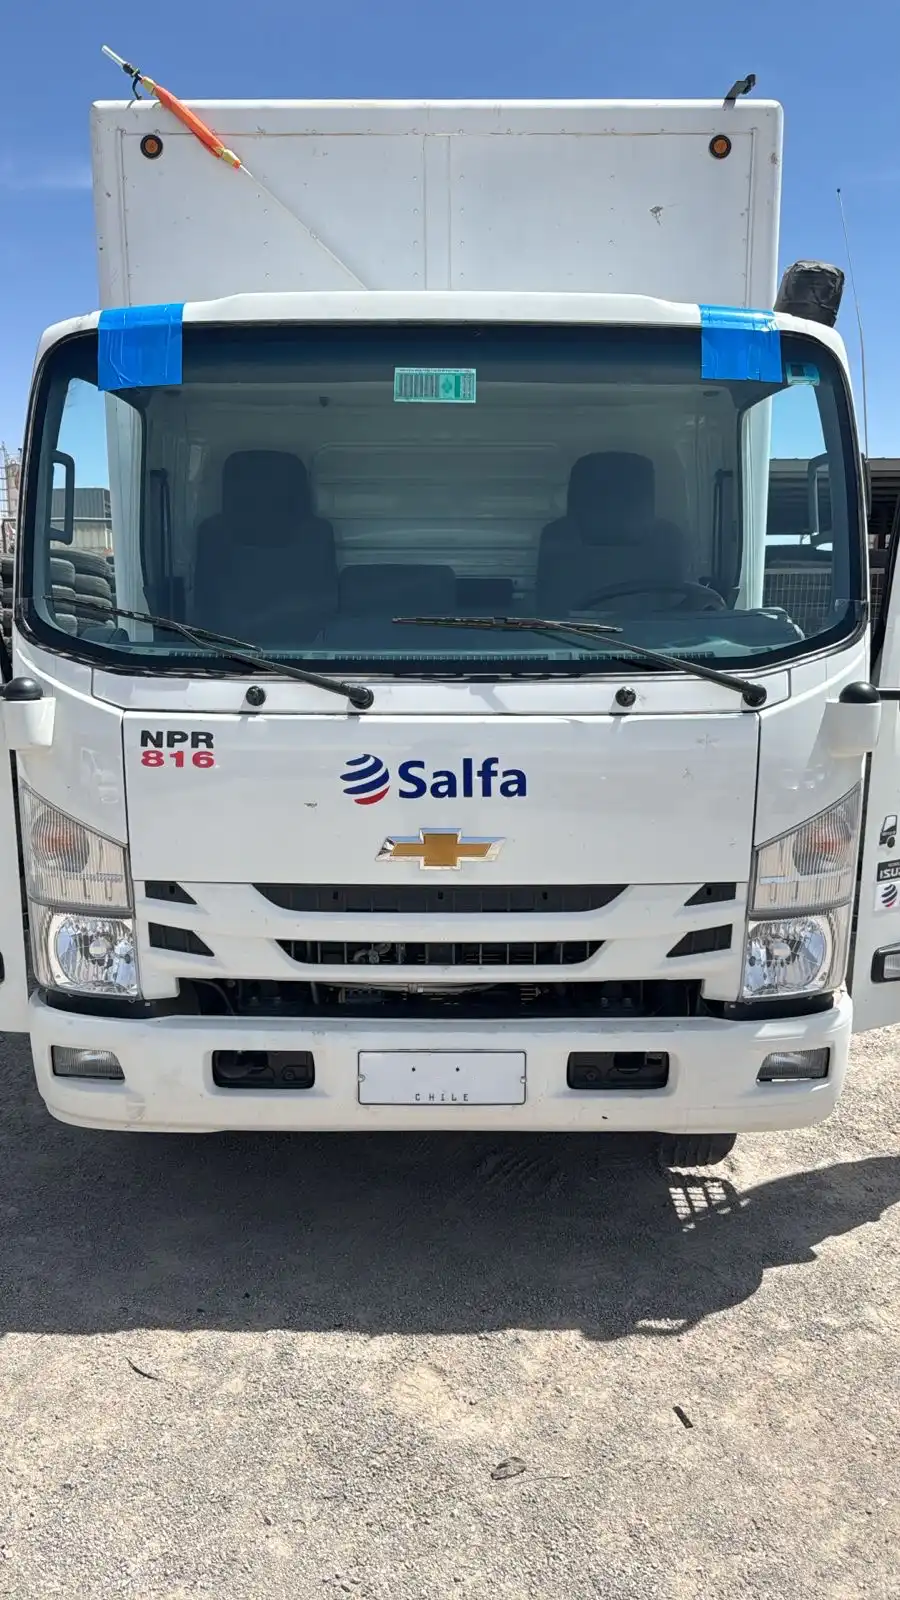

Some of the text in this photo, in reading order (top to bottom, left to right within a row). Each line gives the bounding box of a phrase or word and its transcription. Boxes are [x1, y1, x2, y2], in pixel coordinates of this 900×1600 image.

[140, 730, 214, 748] NPR
[141, 750, 215, 768] 816
[398, 757, 527, 799] Salfa
[880, 867, 900, 879] ISU
[415, 1093, 469, 1102] CHILE
